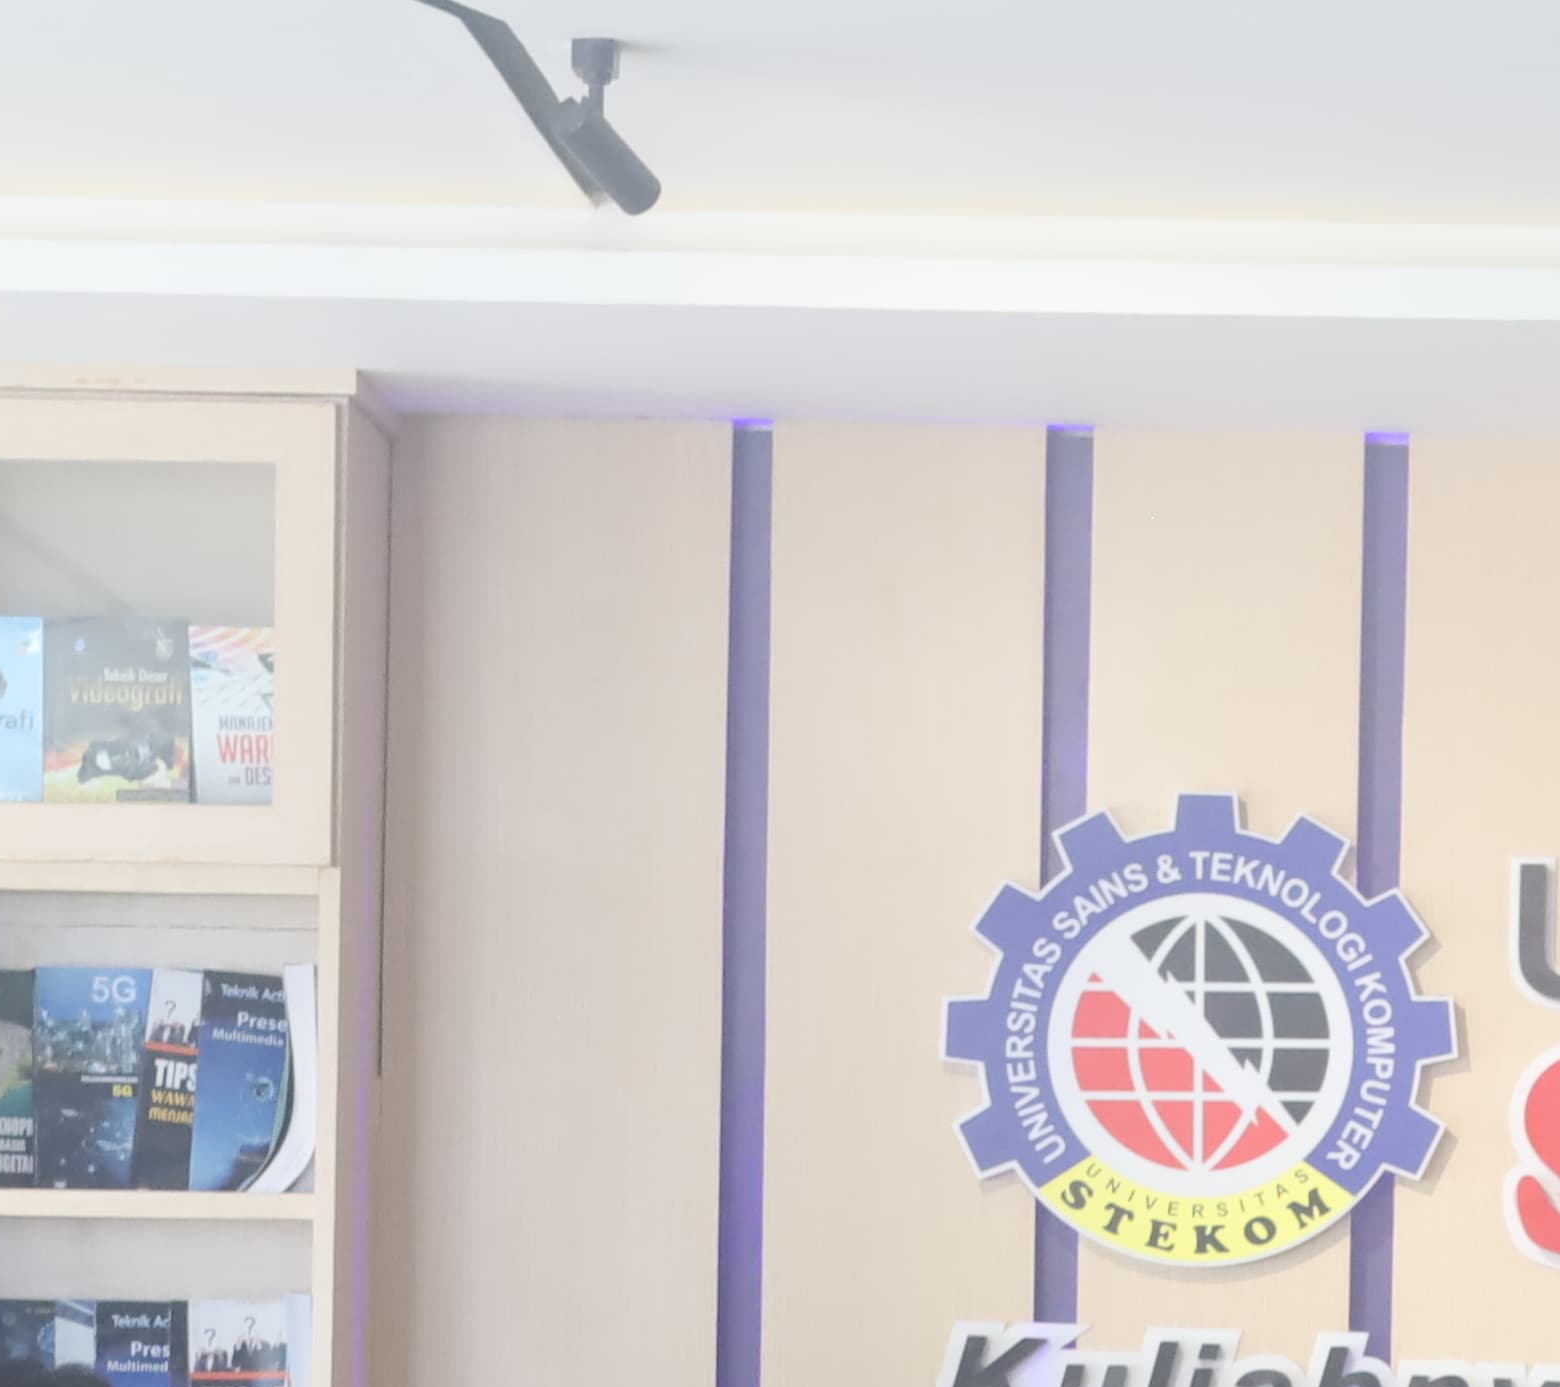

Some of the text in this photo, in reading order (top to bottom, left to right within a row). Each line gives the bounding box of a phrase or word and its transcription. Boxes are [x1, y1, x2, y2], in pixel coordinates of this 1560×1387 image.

[91, 974, 138, 1006] 5G
[220, 982, 260, 1000] Teknik
[1004, 850, 1396, 1173] UNIVERSITAS SAINS & TEKNOLOGI KOMPUTER
[211, 1027, 285, 1048] Multimedia
[153, 1057, 198, 1092] TIPS
[111, 1083, 135, 1099] 5G
[1085, 1162, 1309, 1219] UNIVERSITAS
[1060, 1179, 1333, 1256] STEKOM
[111, 1314, 151, 1329] Teknik
